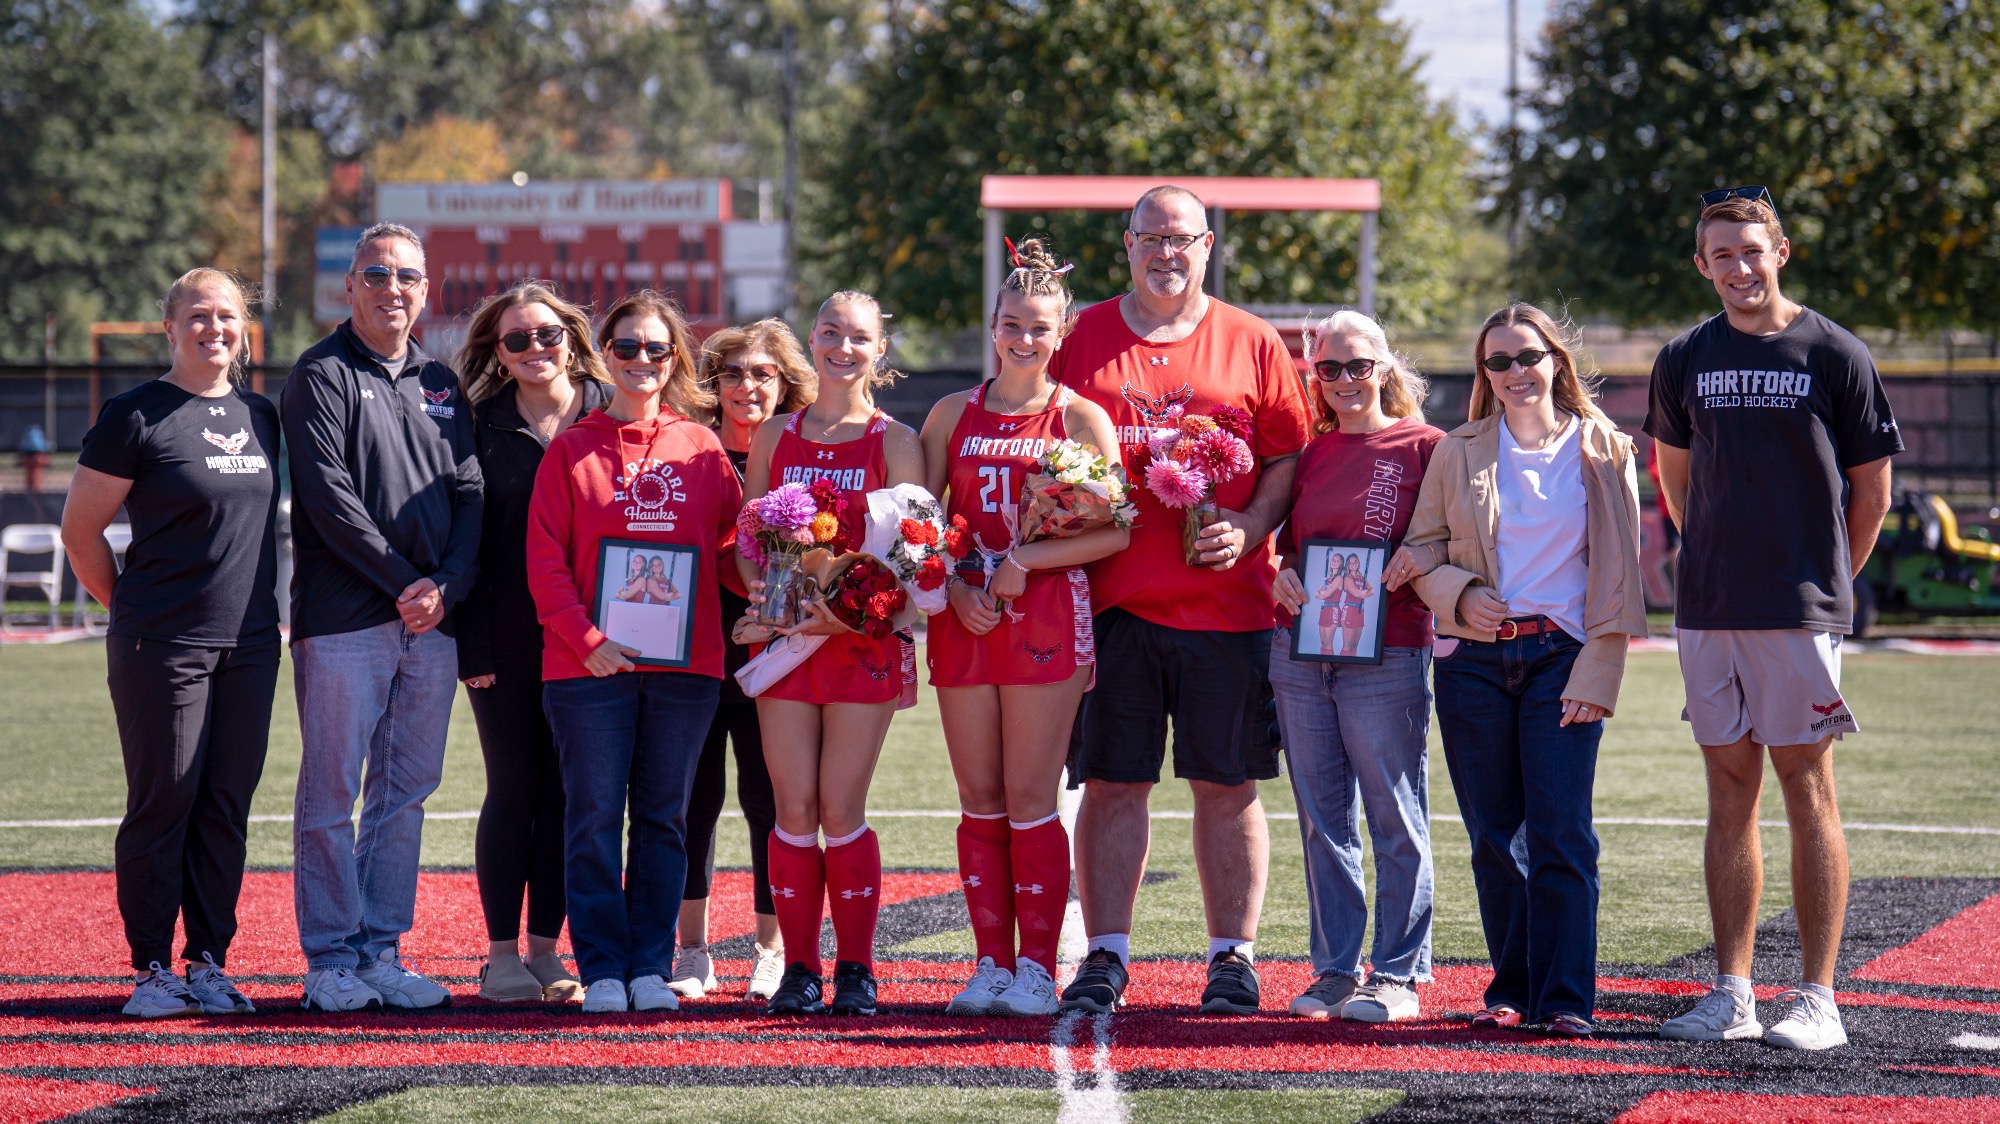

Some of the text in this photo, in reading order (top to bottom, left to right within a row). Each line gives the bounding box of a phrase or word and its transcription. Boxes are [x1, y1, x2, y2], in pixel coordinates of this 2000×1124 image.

[595, 186, 705, 212] Hartford
[1696, 370, 1812, 397] HARTFORD
[1704, 396, 1798, 409] FIELD HOCKEY
[960, 435, 1046, 458] HARTFORD
[205, 455, 267, 469] HARTFORD
[614, 457, 687, 503] HARTFORD
[978, 466, 1011, 513] 21
[624, 505, 678, 521] Hawks
[1810, 714, 1852, 733] HARTFORD
